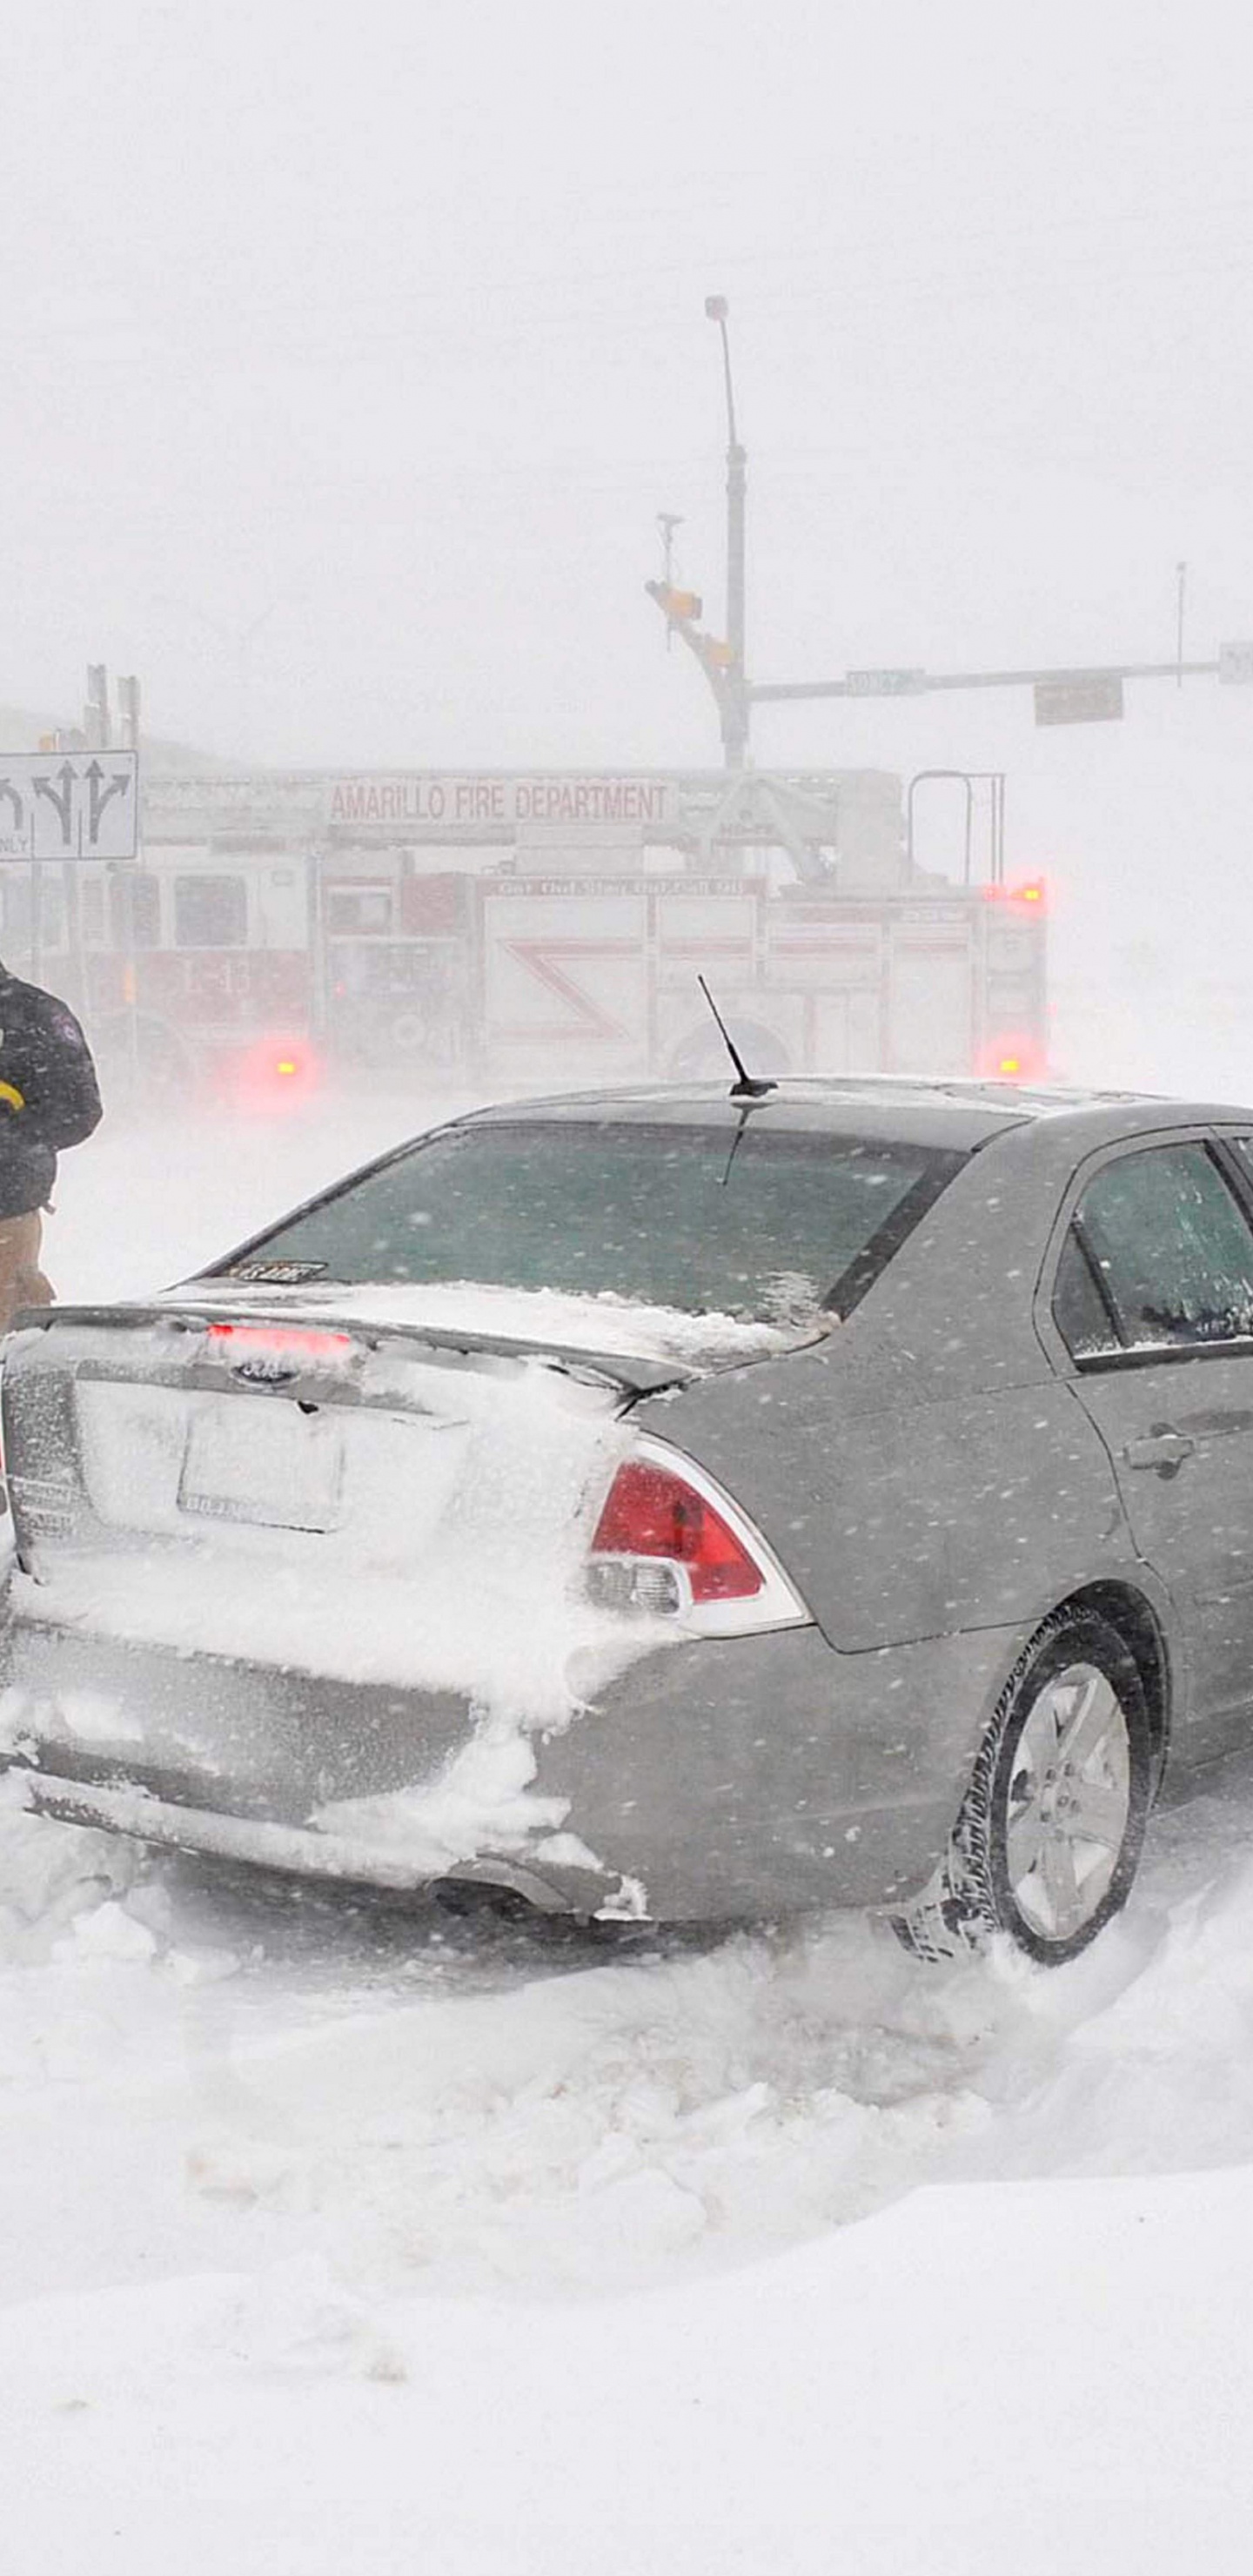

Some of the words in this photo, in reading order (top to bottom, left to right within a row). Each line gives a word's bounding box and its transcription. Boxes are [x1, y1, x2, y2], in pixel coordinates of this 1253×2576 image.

[331, 785, 445, 819] AMARILLO
[456, 785, 505, 819] FIRE
[515, 785, 667, 819] DEPARTMENT
[0, 835, 30, 854] NLY
